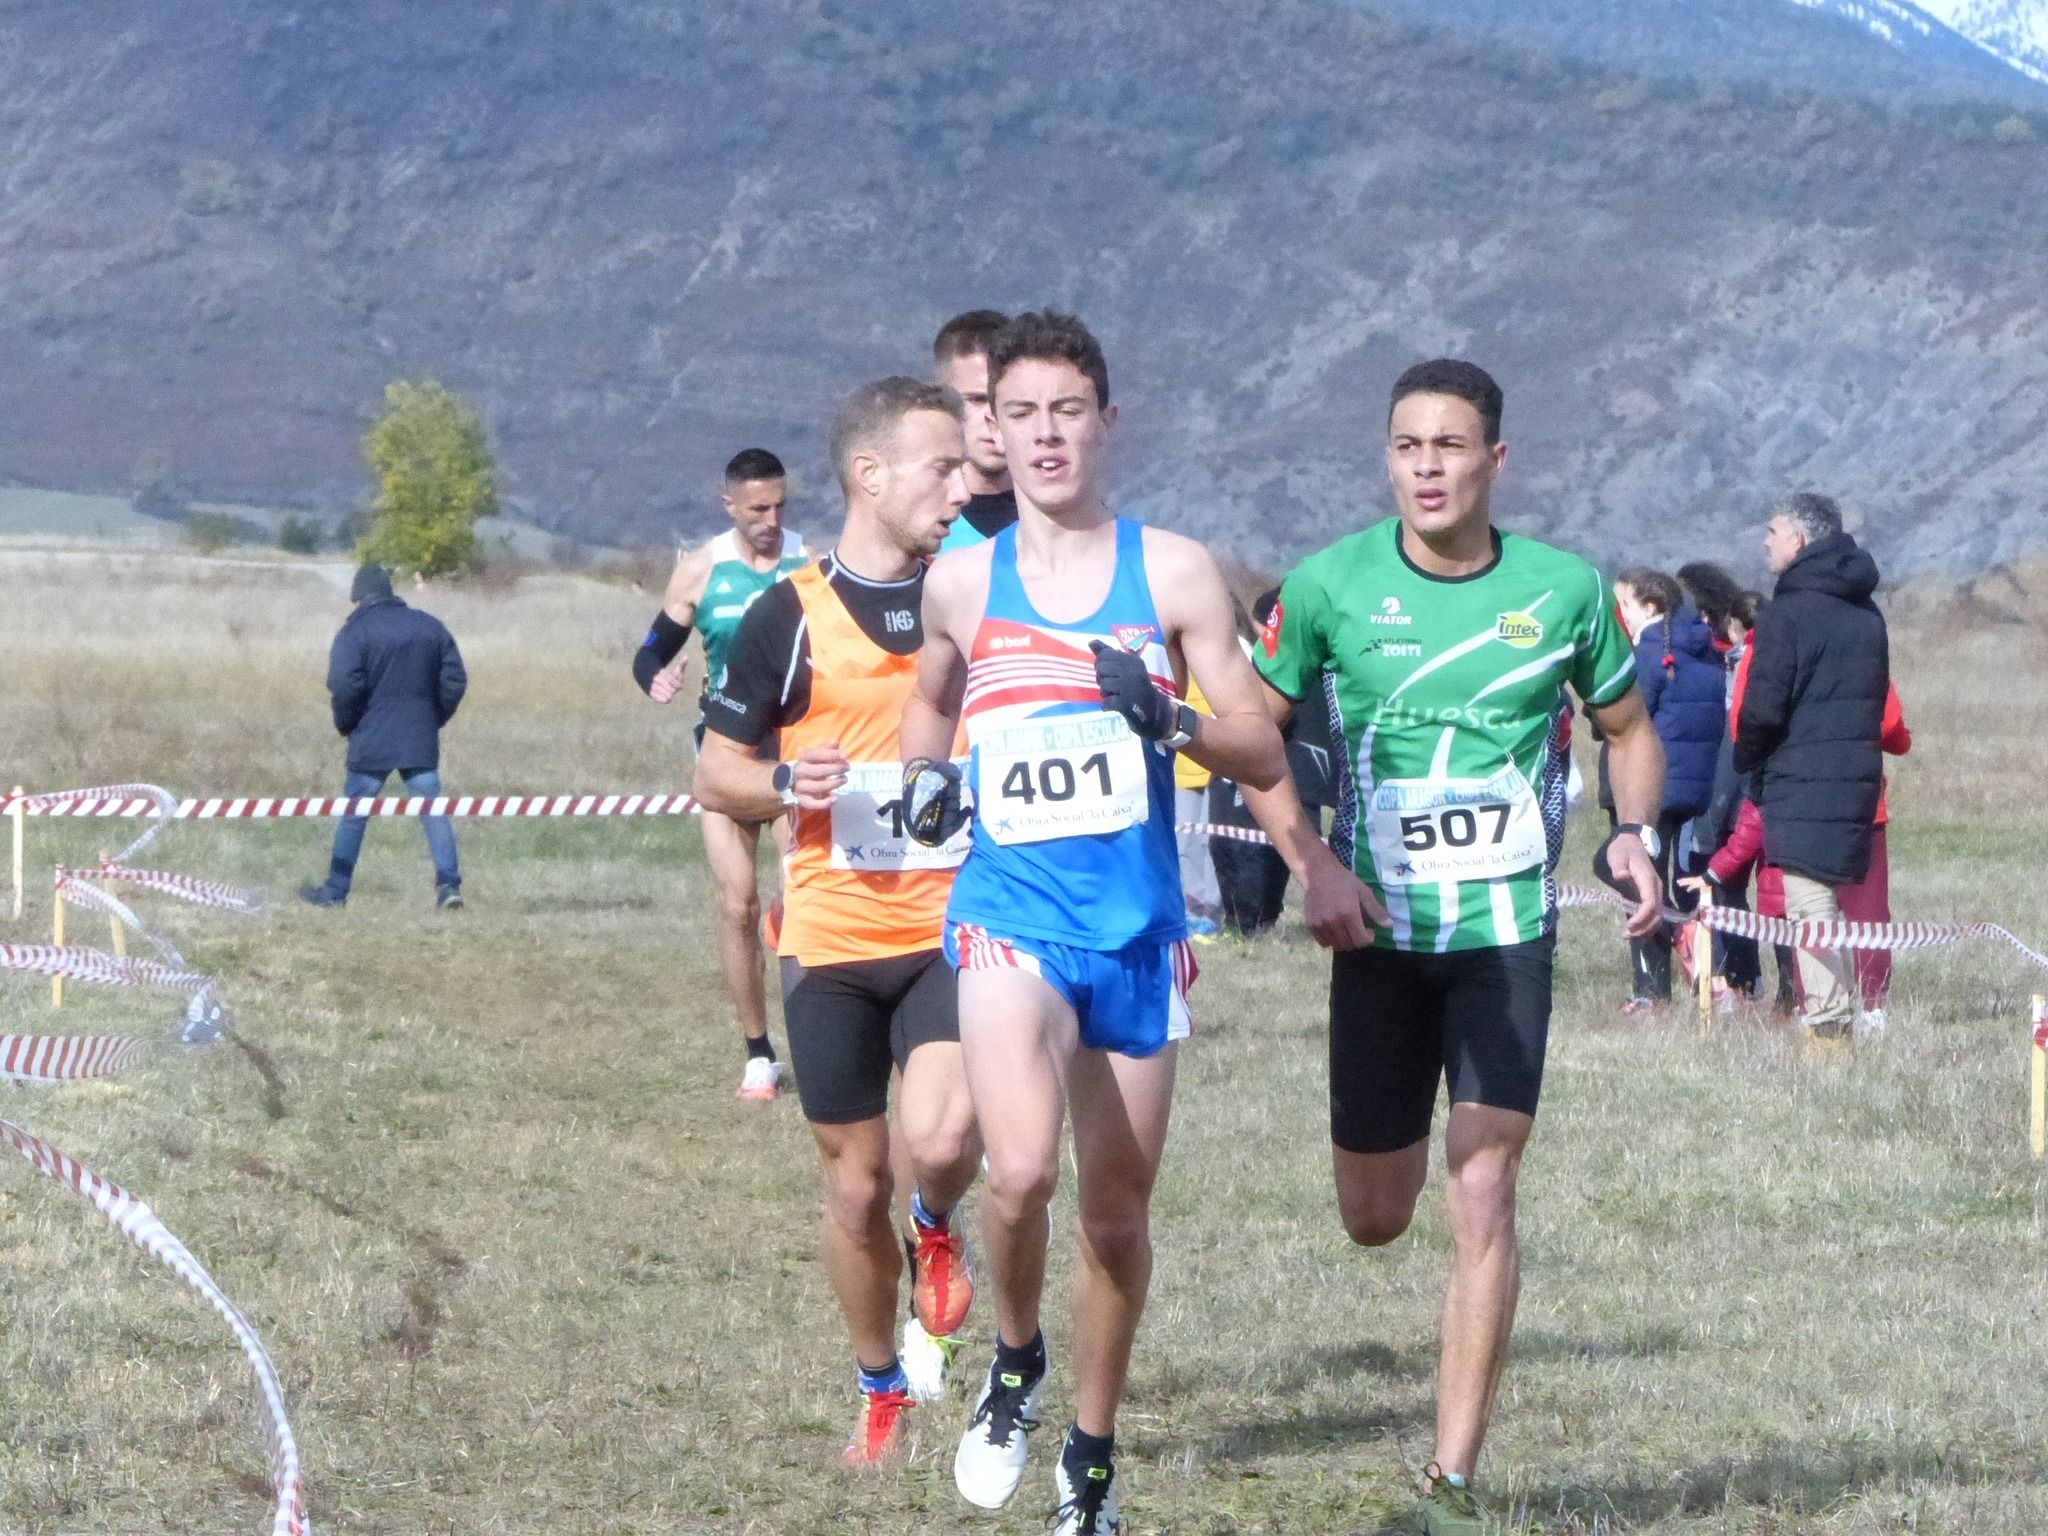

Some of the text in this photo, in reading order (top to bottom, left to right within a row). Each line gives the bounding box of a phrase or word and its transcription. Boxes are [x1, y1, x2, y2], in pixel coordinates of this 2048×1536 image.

[1370, 614, 1413, 626] VIATOR
[1375, 697, 1521, 730] Huesca
[1001, 752, 1113, 805] 401
[1400, 804, 1512, 851] 507
[870, 847, 898, 858] Obra
[900, 847, 930, 858] Social
[1421, 859, 1451, 871] Obra
[1452, 856, 1485, 868] Social
